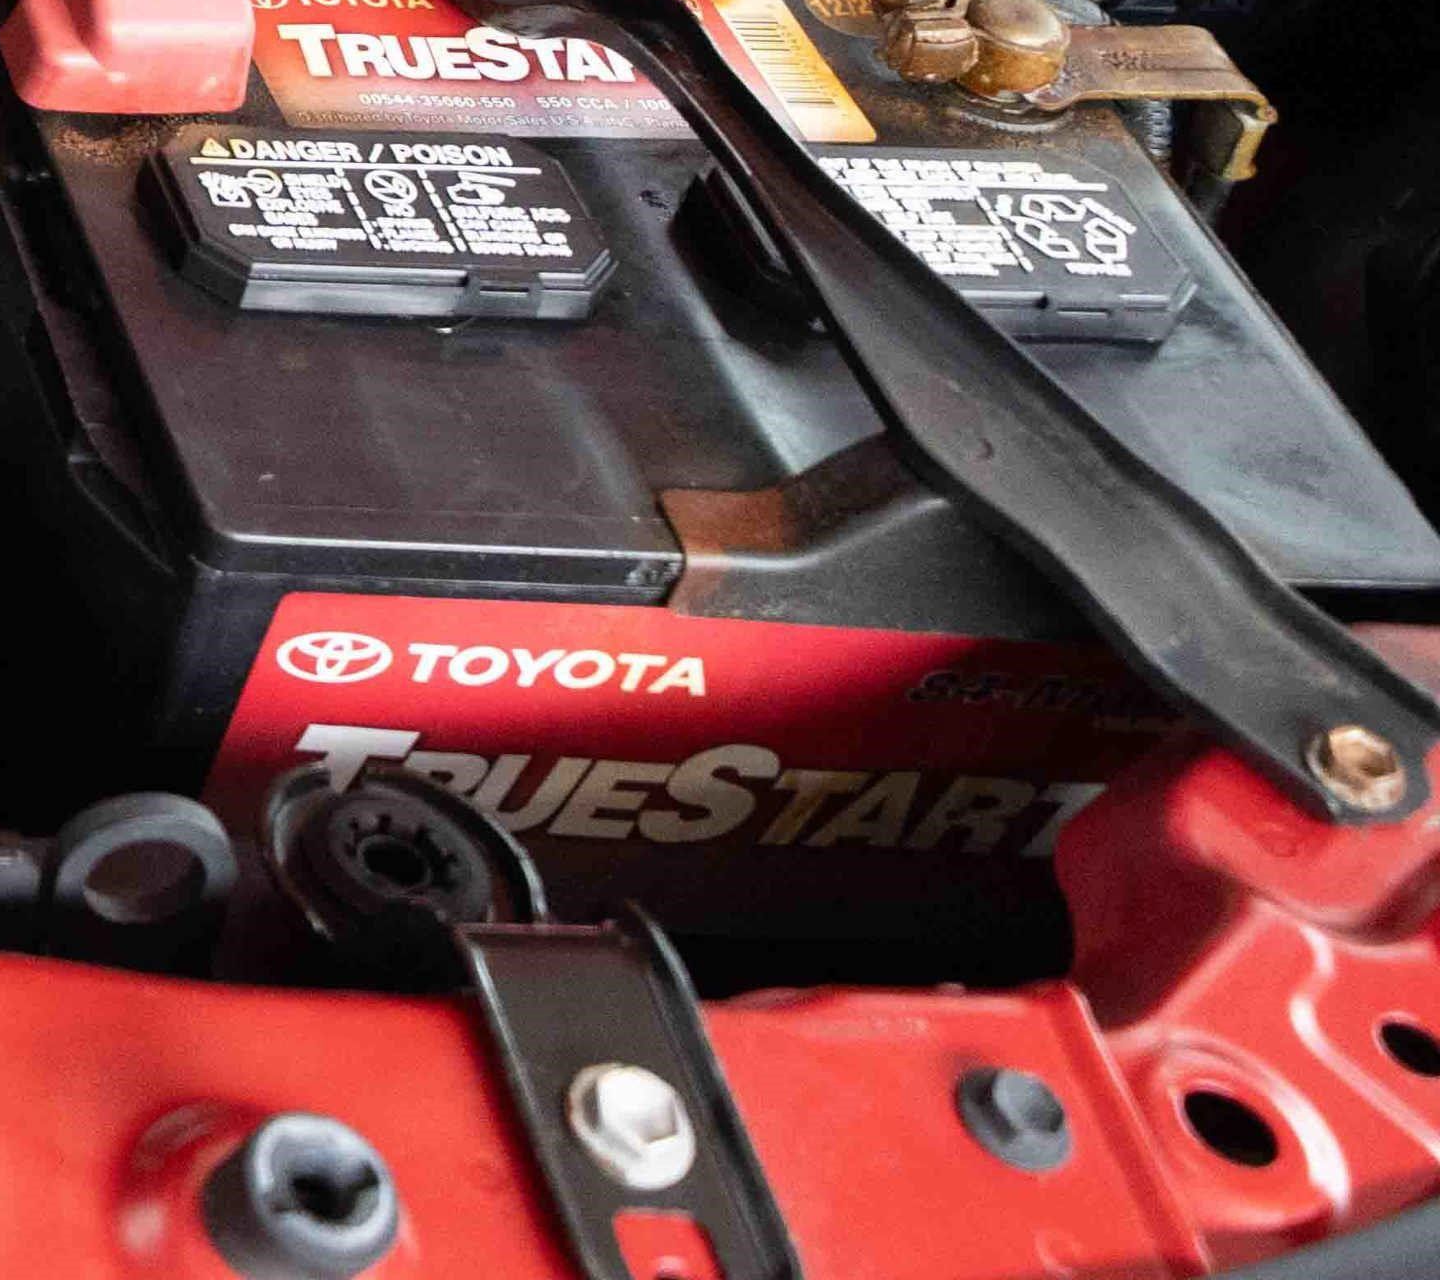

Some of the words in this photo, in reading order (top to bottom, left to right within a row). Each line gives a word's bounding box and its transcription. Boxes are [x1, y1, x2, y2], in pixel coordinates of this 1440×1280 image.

[536, 95, 573, 109] 550
[576, 96, 618, 110] CCA
[229, 139, 362, 163] DANGER
[389, 144, 513, 166] POISON
[409, 643, 706, 697] TOYOTA
